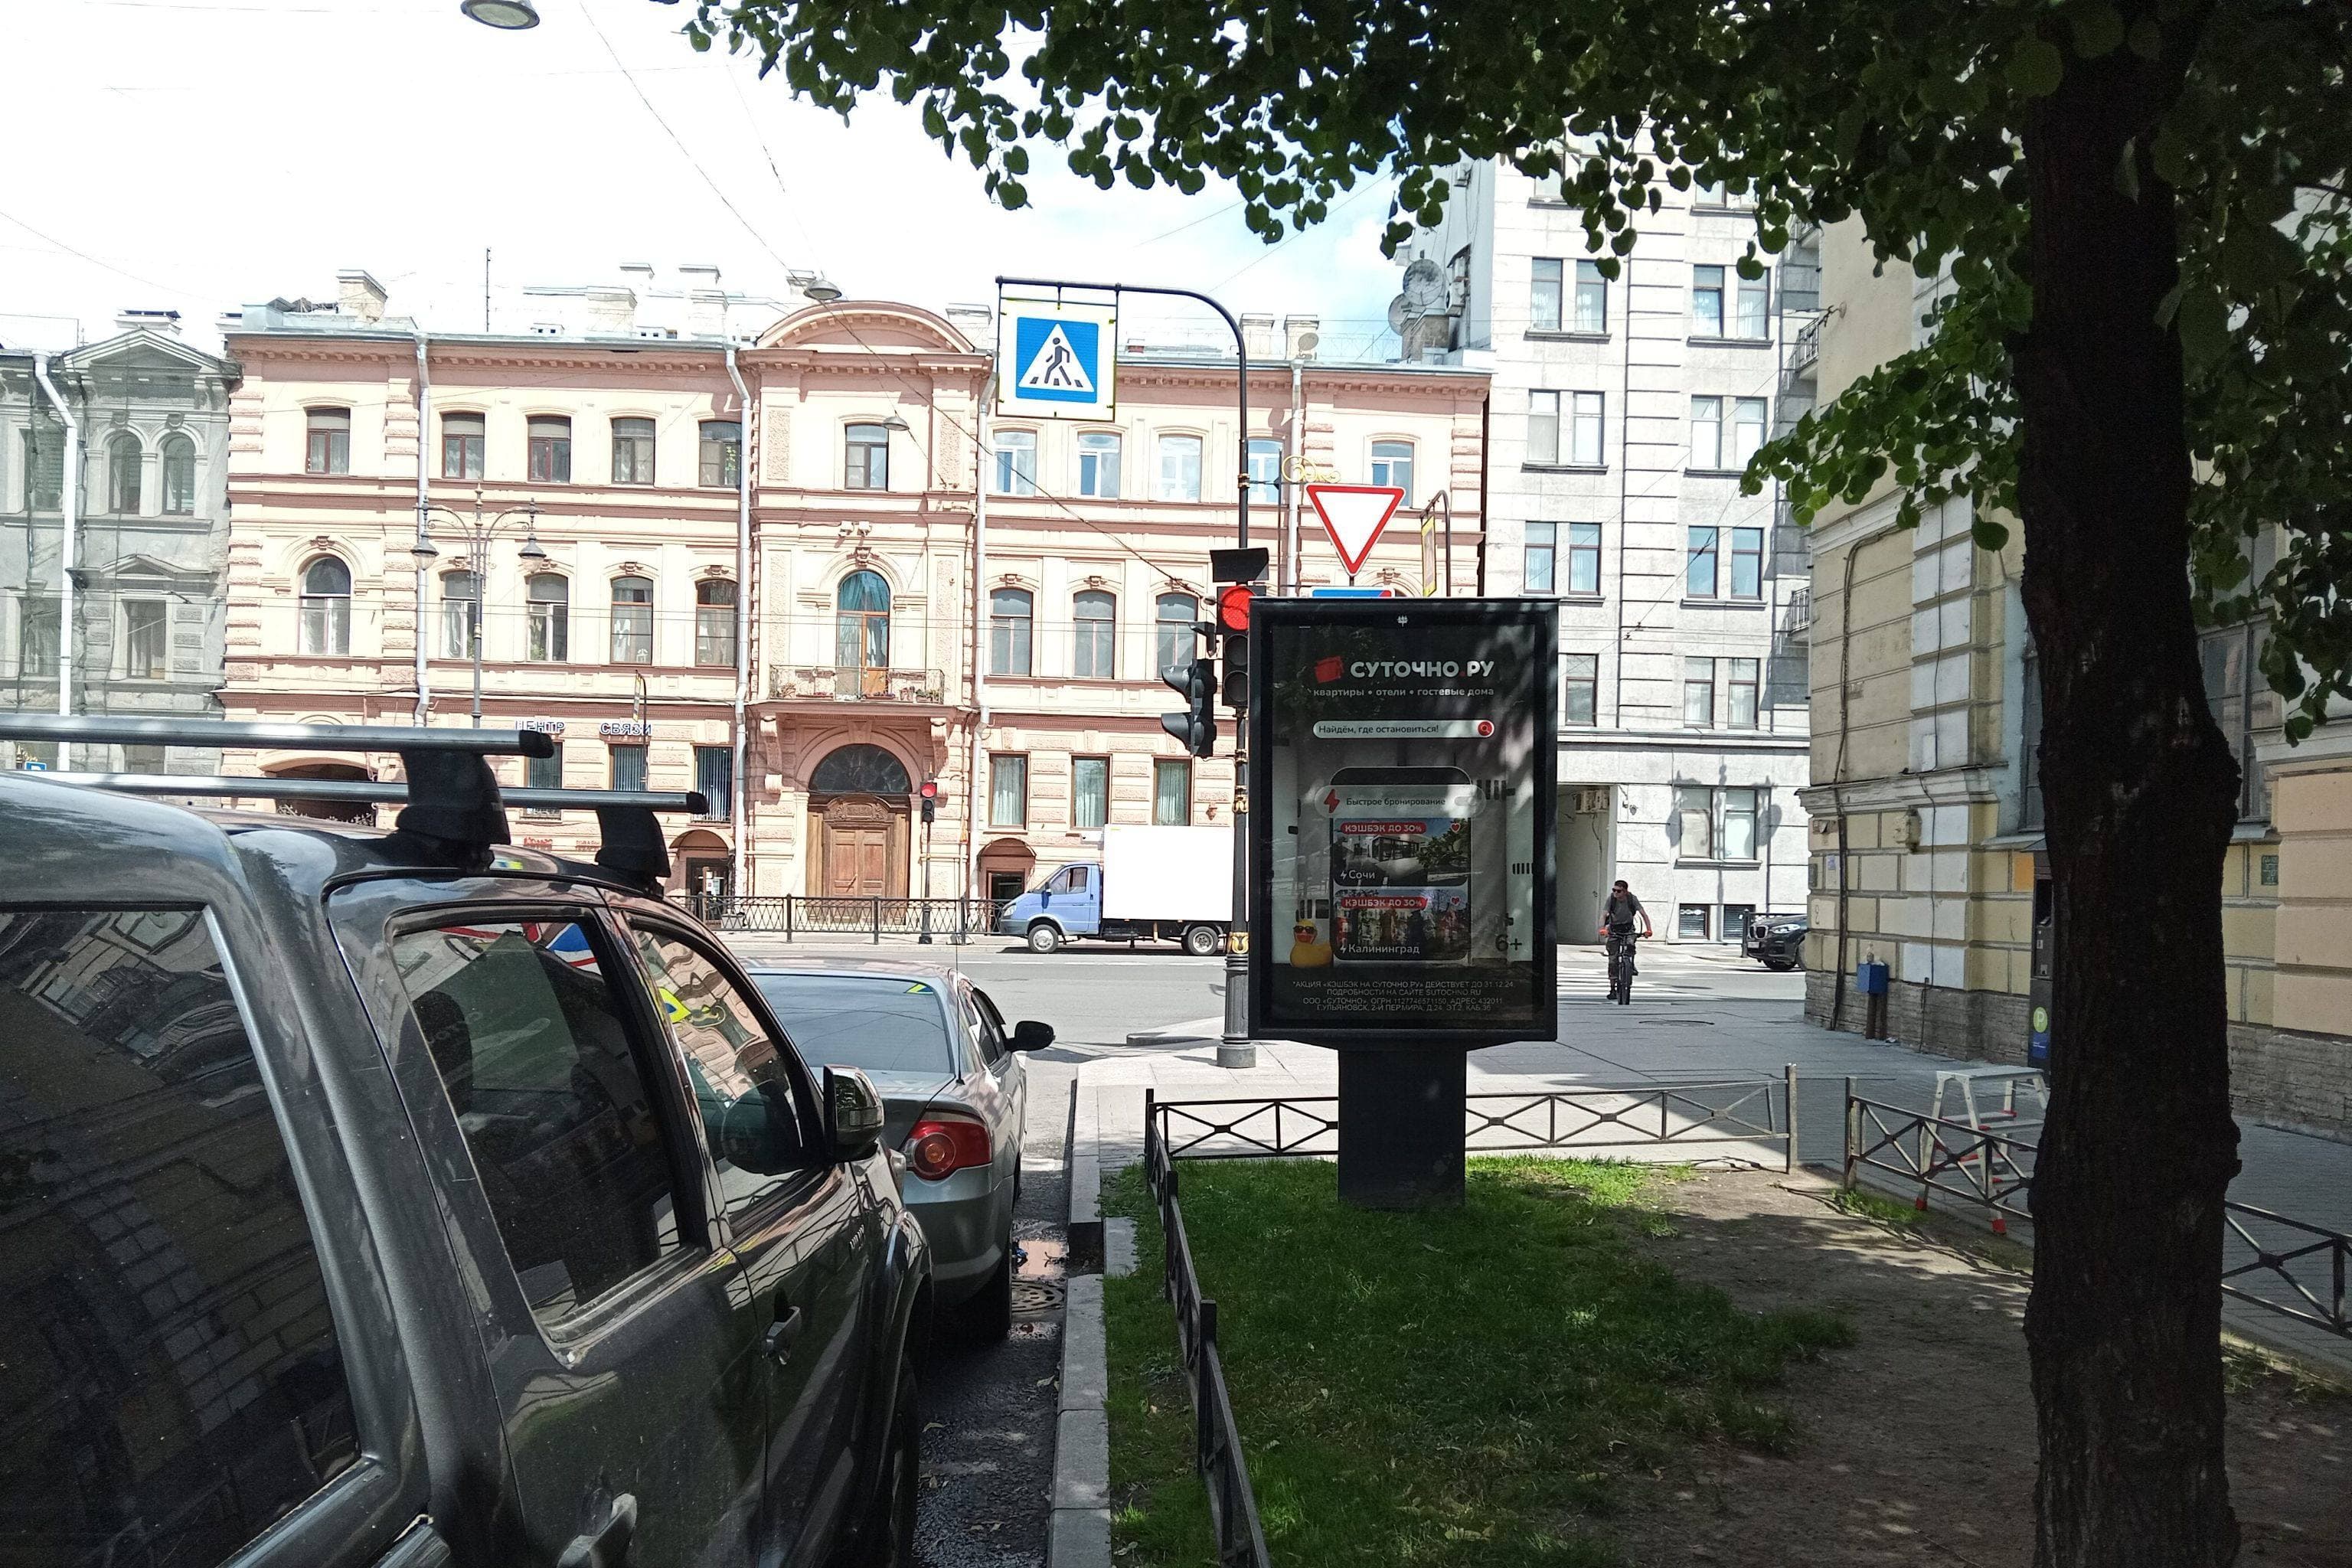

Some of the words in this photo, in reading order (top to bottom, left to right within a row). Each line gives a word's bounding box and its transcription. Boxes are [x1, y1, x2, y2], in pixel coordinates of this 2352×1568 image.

[1350, 660, 1494, 678] СУТОЧНО.РУ
[1313, 689, 1364, 698] квартиры
[1467, 689, 1494, 697] дома
[515, 720, 565, 733] ЦЕНТР
[600, 722, 652, 735] СВЯЗИ
[1318, 725, 1357, 734] Найдём,
[1376, 725, 1439, 733] остановиться!
[1346, 798, 1382, 806] Быстрое
[1383, 798, 1446, 806] бронирование
[1388, 825, 1401, 833] ДО
[1348, 871, 1375, 879] Сочи
[1388, 899, 1402, 907] ДО
[1495, 934, 1522, 952] 6+
[1348, 945, 1420, 954] Калининград
[1426, 980, 1470, 988] ДЕЙСТВУЕТ
